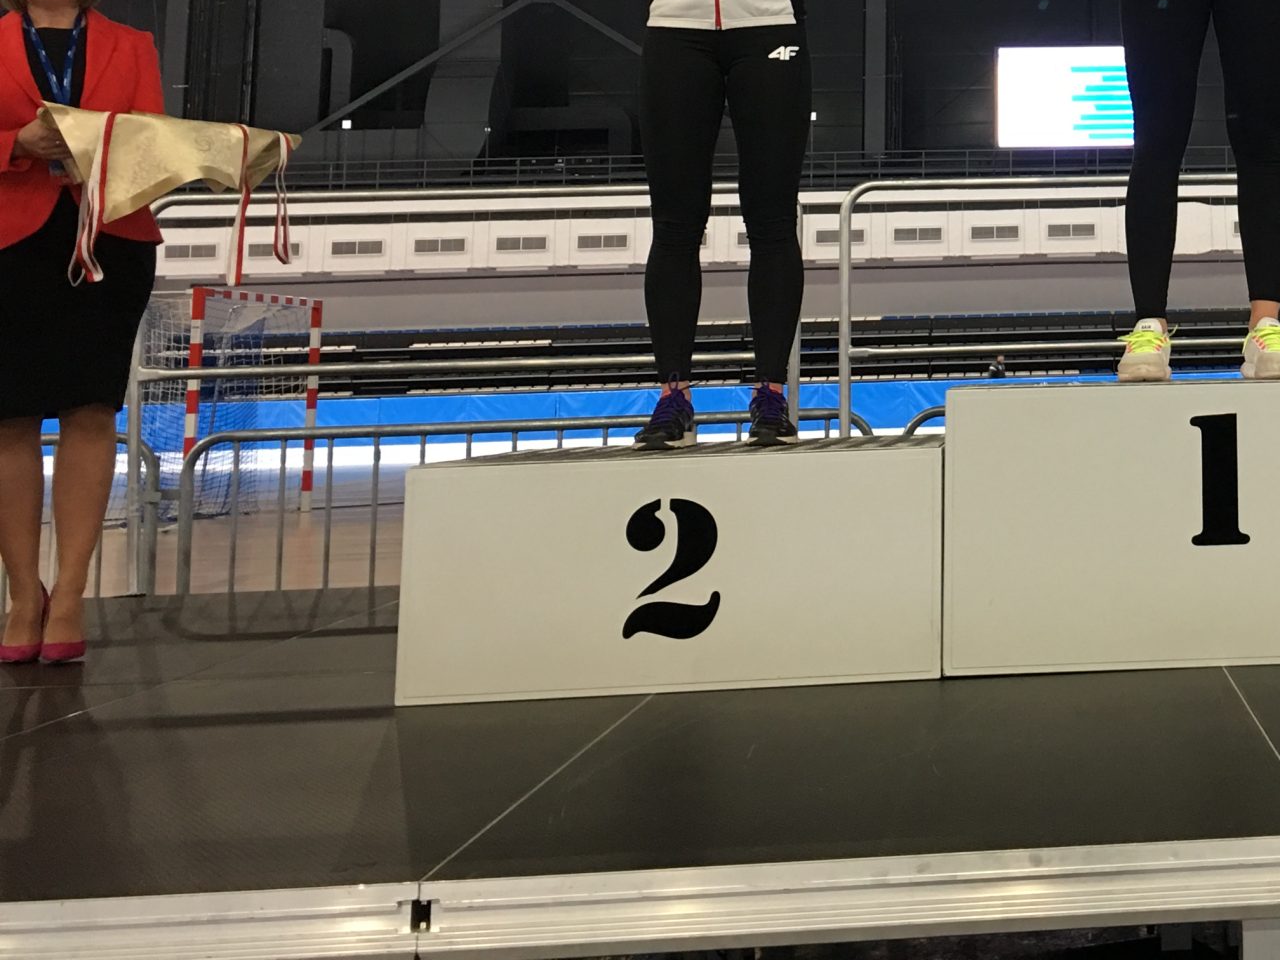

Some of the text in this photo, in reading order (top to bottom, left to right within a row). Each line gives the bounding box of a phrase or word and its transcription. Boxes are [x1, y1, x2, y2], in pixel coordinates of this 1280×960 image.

[768, 46, 800, 61] 4F
[1190, 413, 1250, 546] 1
[622, 498, 720, 640] 2
